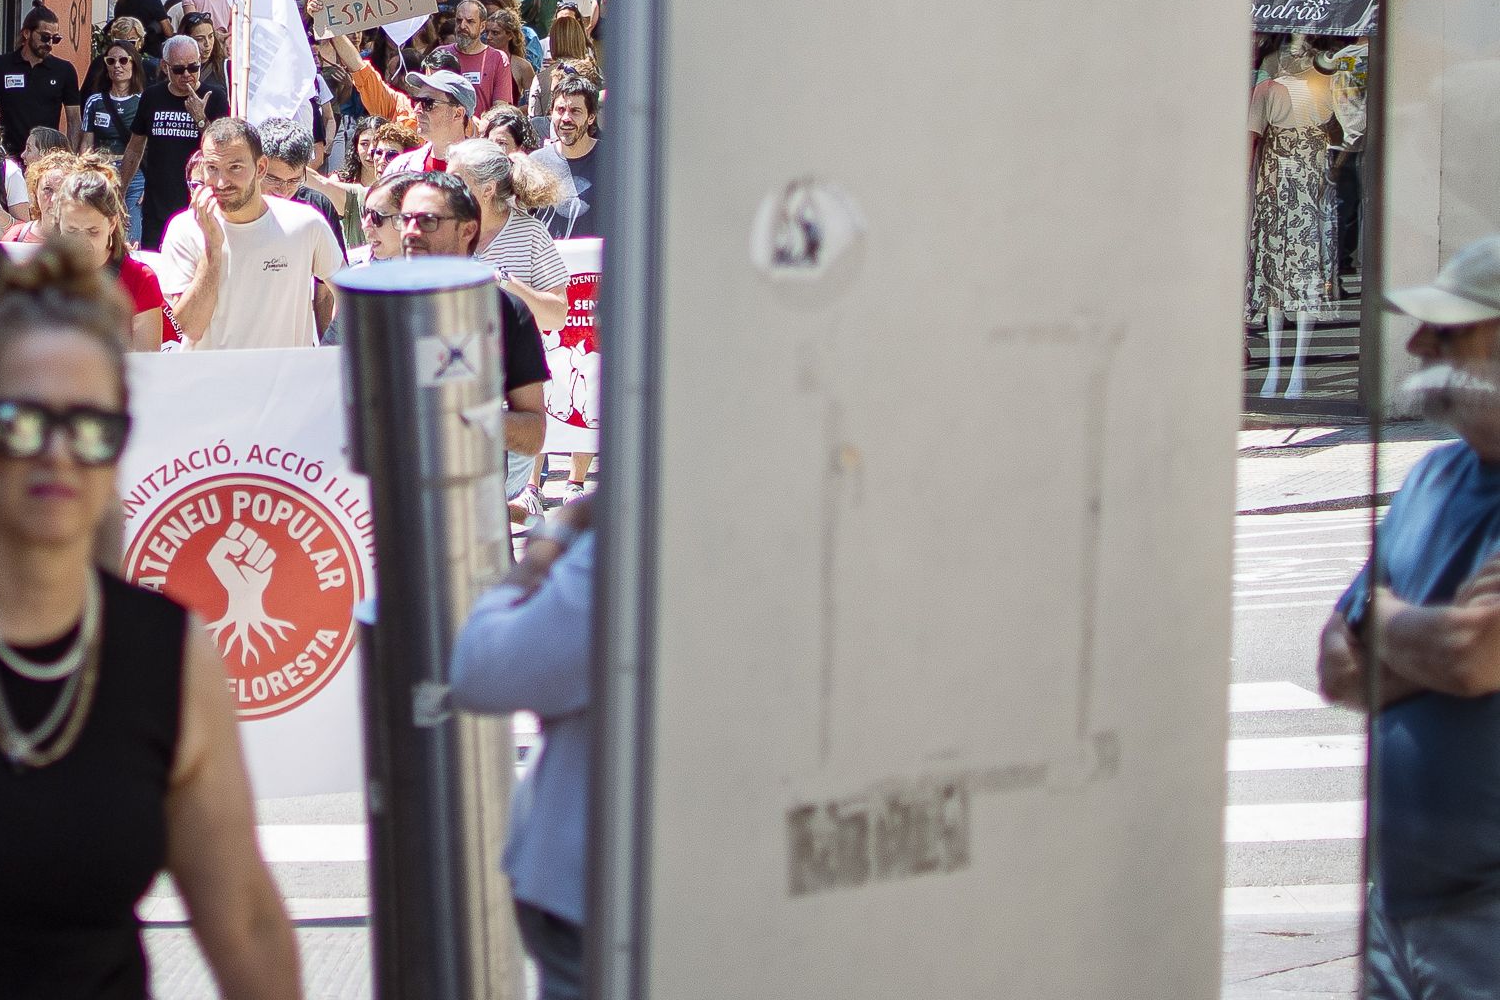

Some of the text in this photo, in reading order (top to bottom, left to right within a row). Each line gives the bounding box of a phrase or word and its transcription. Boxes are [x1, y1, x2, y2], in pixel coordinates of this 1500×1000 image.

[151, 127, 199, 139] BIBLIOTEQUES
[246, 444, 325, 484] ACCIÓ
[323, 477, 338, 494] I
[137, 490, 346, 594] ATENEU POPULAR
